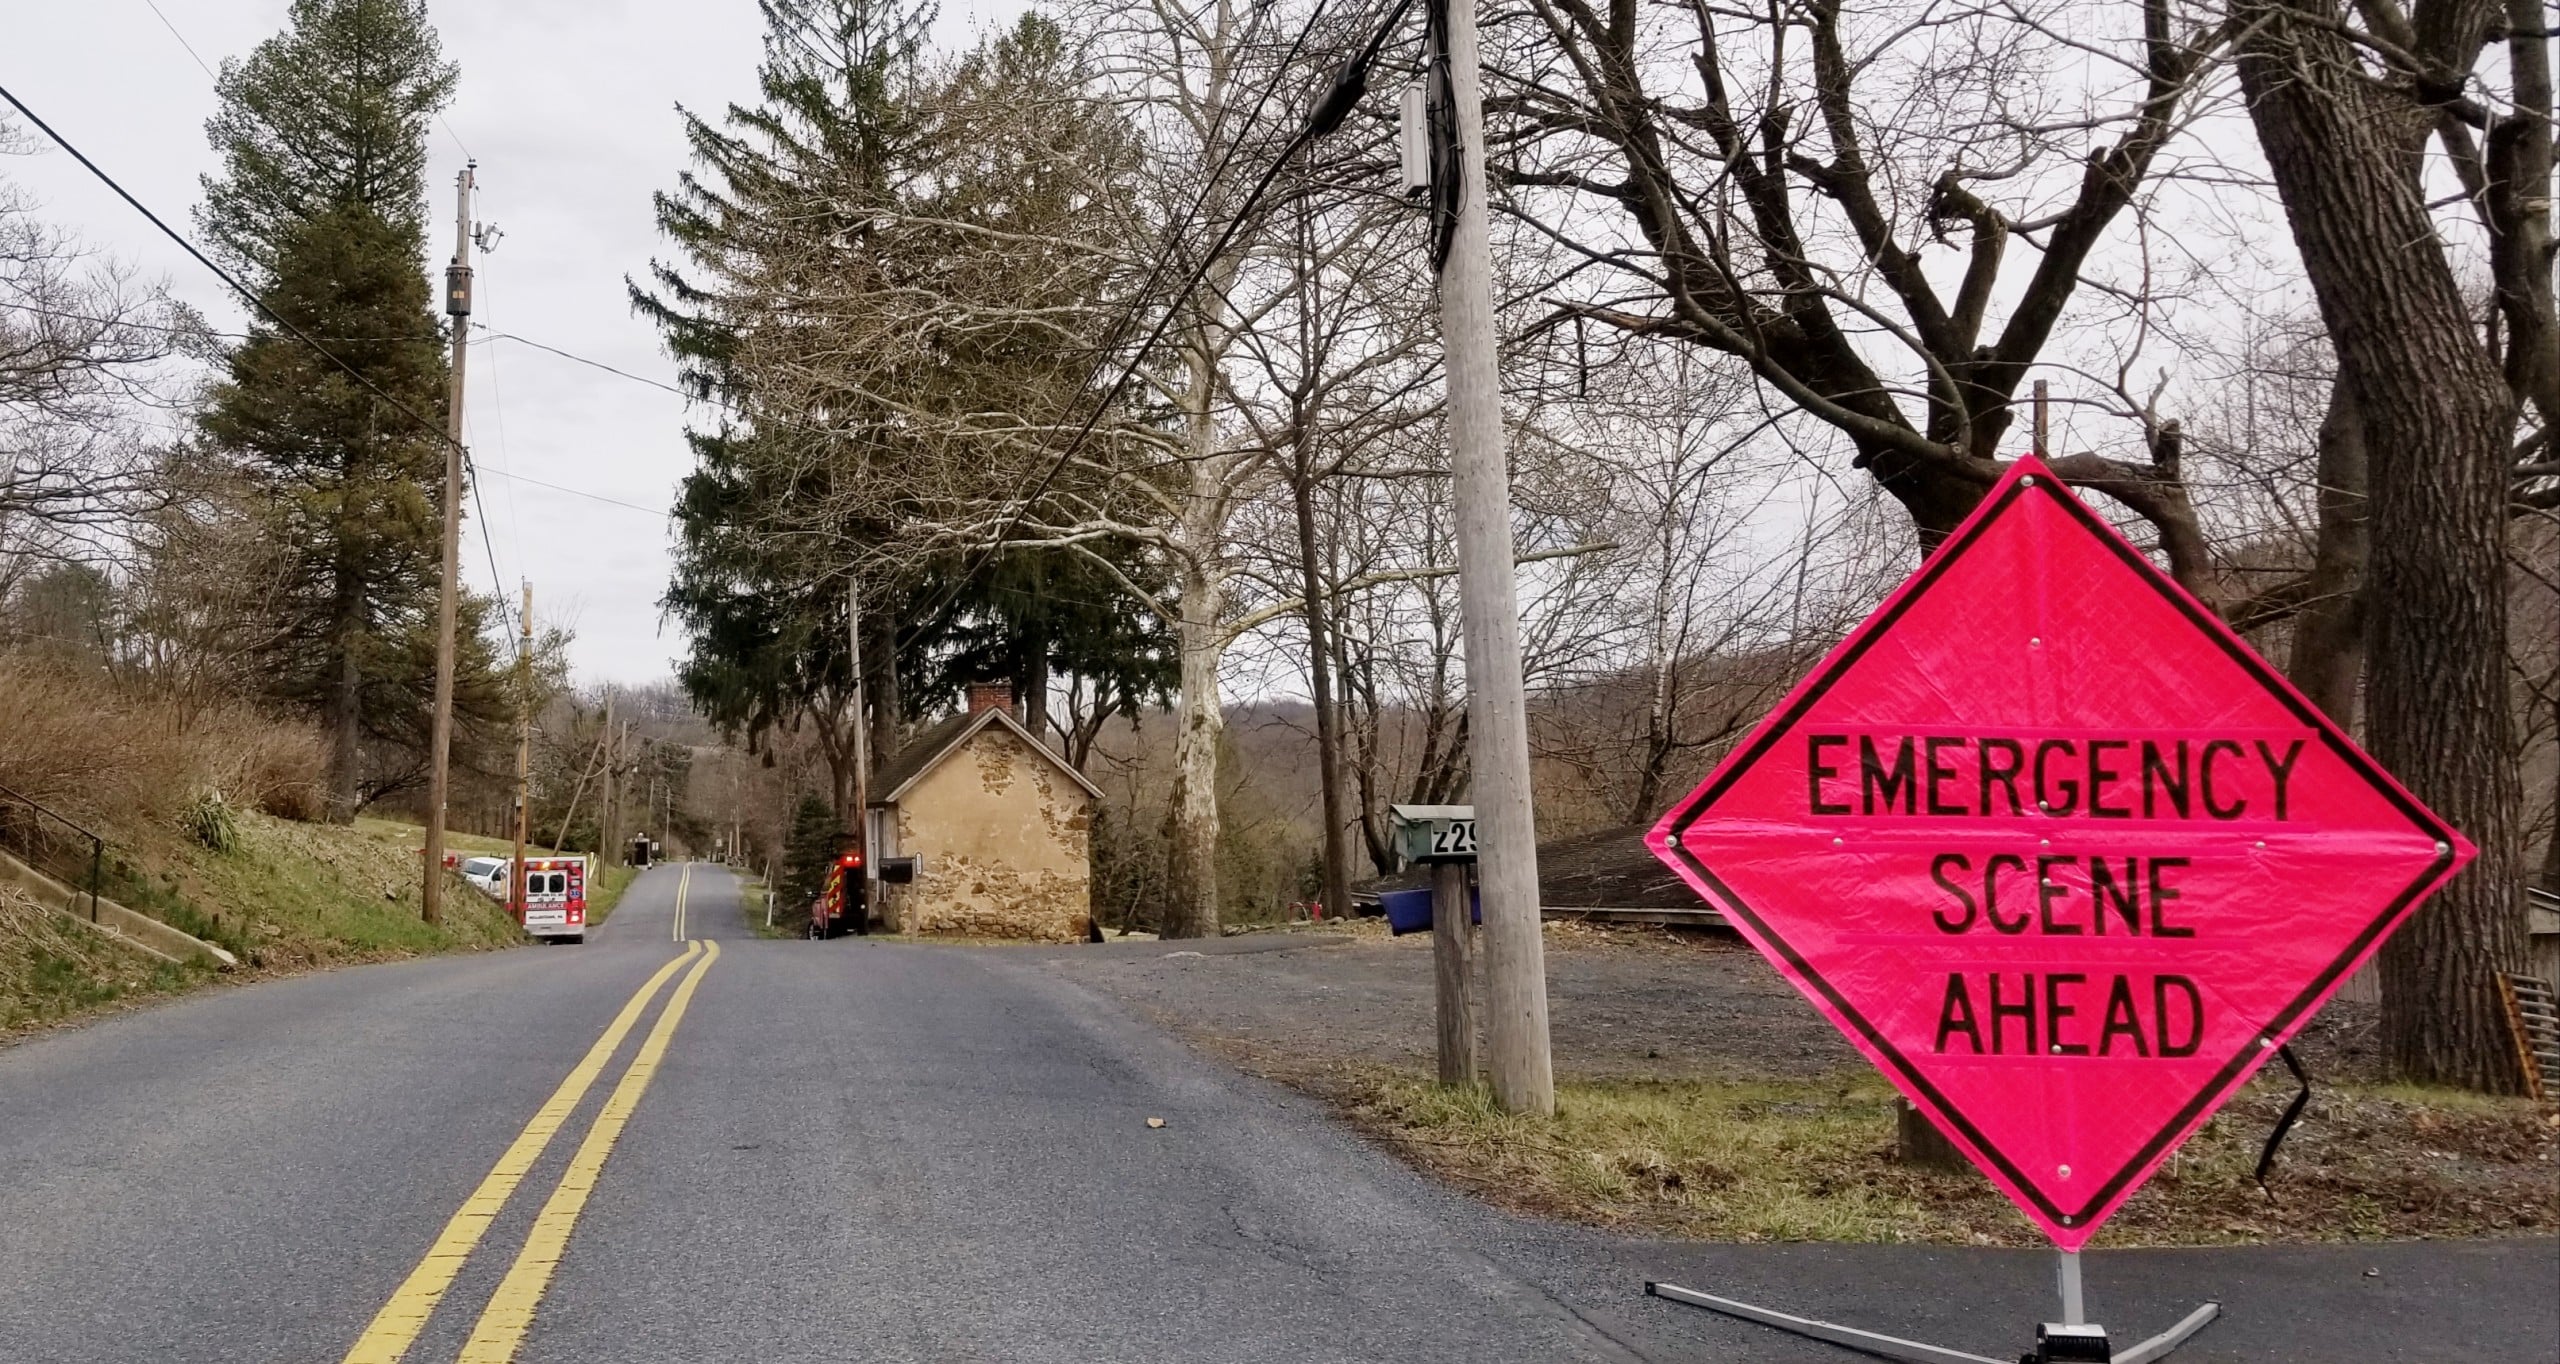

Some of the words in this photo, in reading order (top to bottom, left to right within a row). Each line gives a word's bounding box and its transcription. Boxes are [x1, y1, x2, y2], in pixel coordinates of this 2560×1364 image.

[1808, 735, 2305, 822] EMERGENCY
[1932, 854, 2196, 938] SCENE
[1935, 973, 2203, 1058] AHEAD
